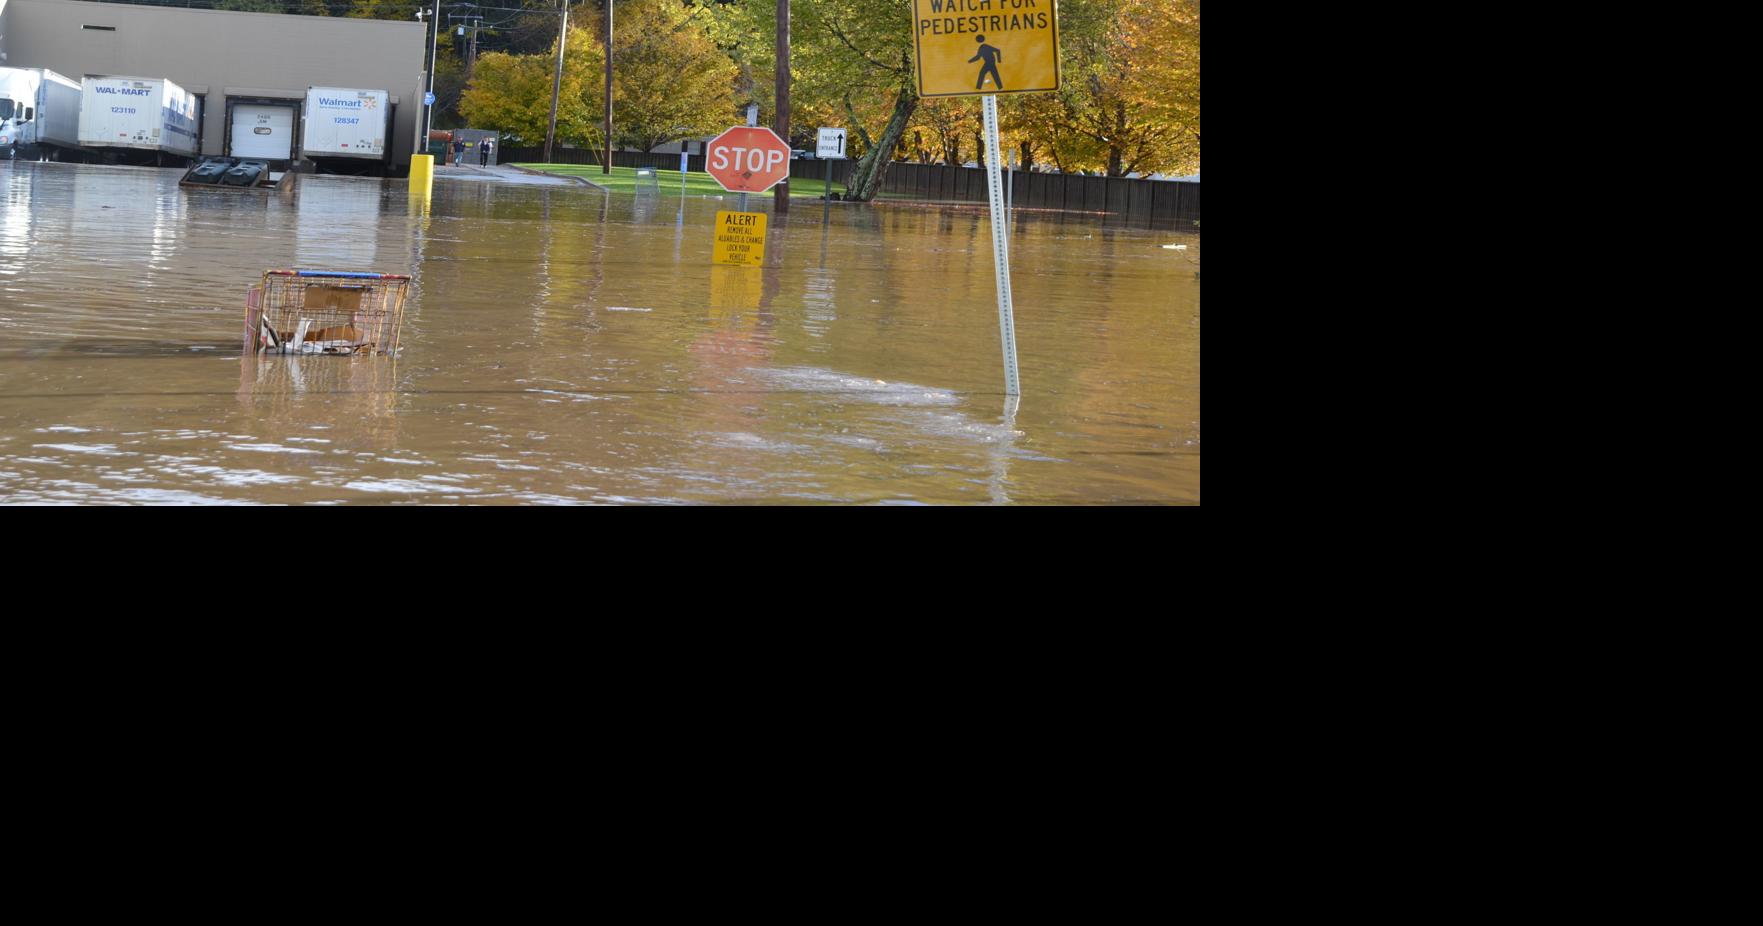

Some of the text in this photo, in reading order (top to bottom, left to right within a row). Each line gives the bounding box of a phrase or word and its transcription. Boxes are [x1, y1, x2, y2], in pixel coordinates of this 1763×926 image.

[931, 0, 991, 13] WATCH
[920, 12, 1048, 36] PEDESTRIANS
[319, 97, 362, 107] Walmart
[111, 106, 136, 114] 123110
[334, 117, 360, 125] 128347
[712, 146, 784, 173] STOP
[725, 214, 757, 226] ALERT
[727, 226, 752, 235] REMOVE ALL
